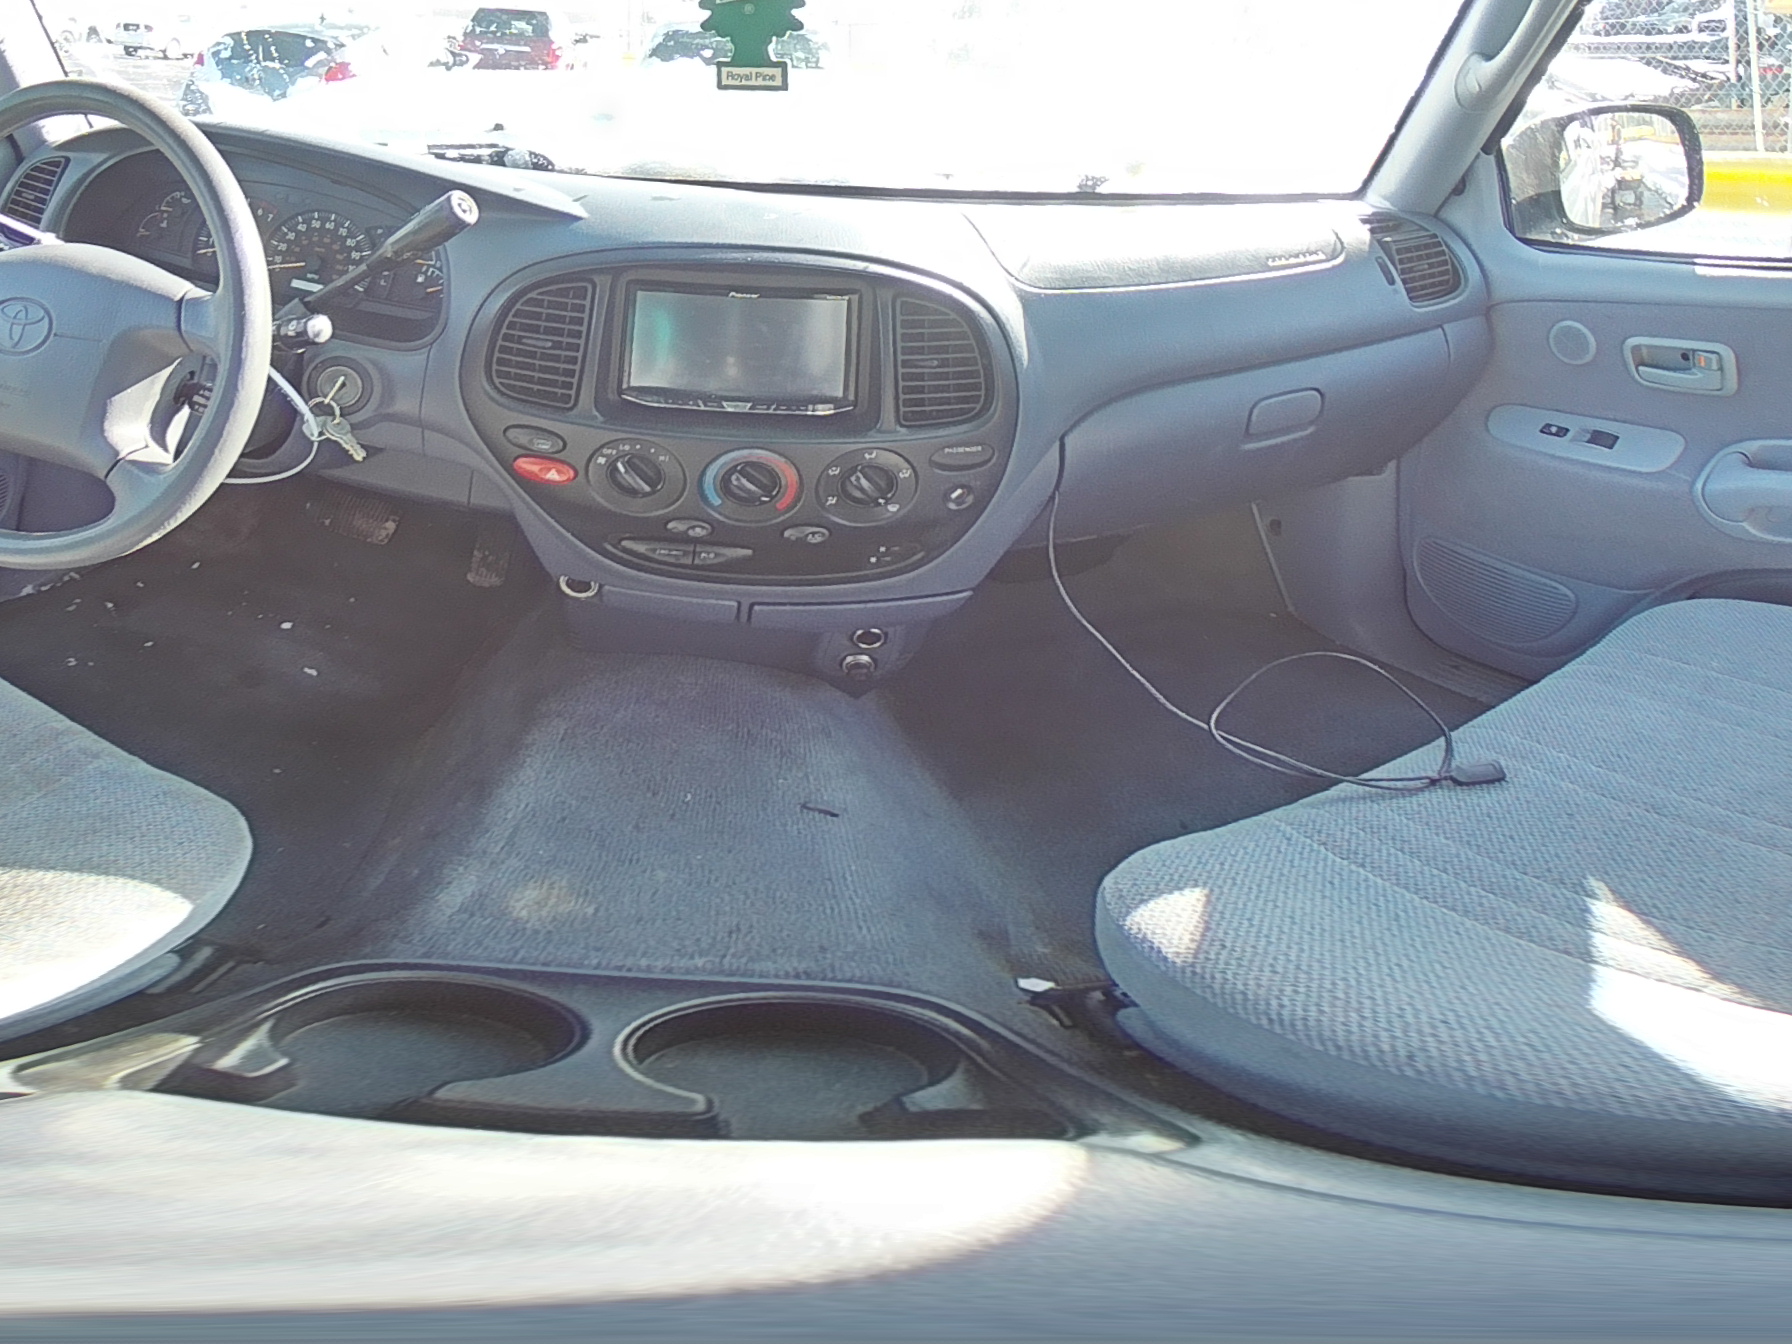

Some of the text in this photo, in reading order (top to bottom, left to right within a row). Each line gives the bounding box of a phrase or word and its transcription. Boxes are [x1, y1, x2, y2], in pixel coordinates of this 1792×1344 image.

[726, 71, 776, 83] Royal Pine
[296, 223, 307, 232] 40
[310, 219, 321, 228] 50
[325, 221, 335, 229] 60
[337, 227, 348, 236] 70
[277, 242, 287, 251] 20
[345, 238, 357, 247] 80
